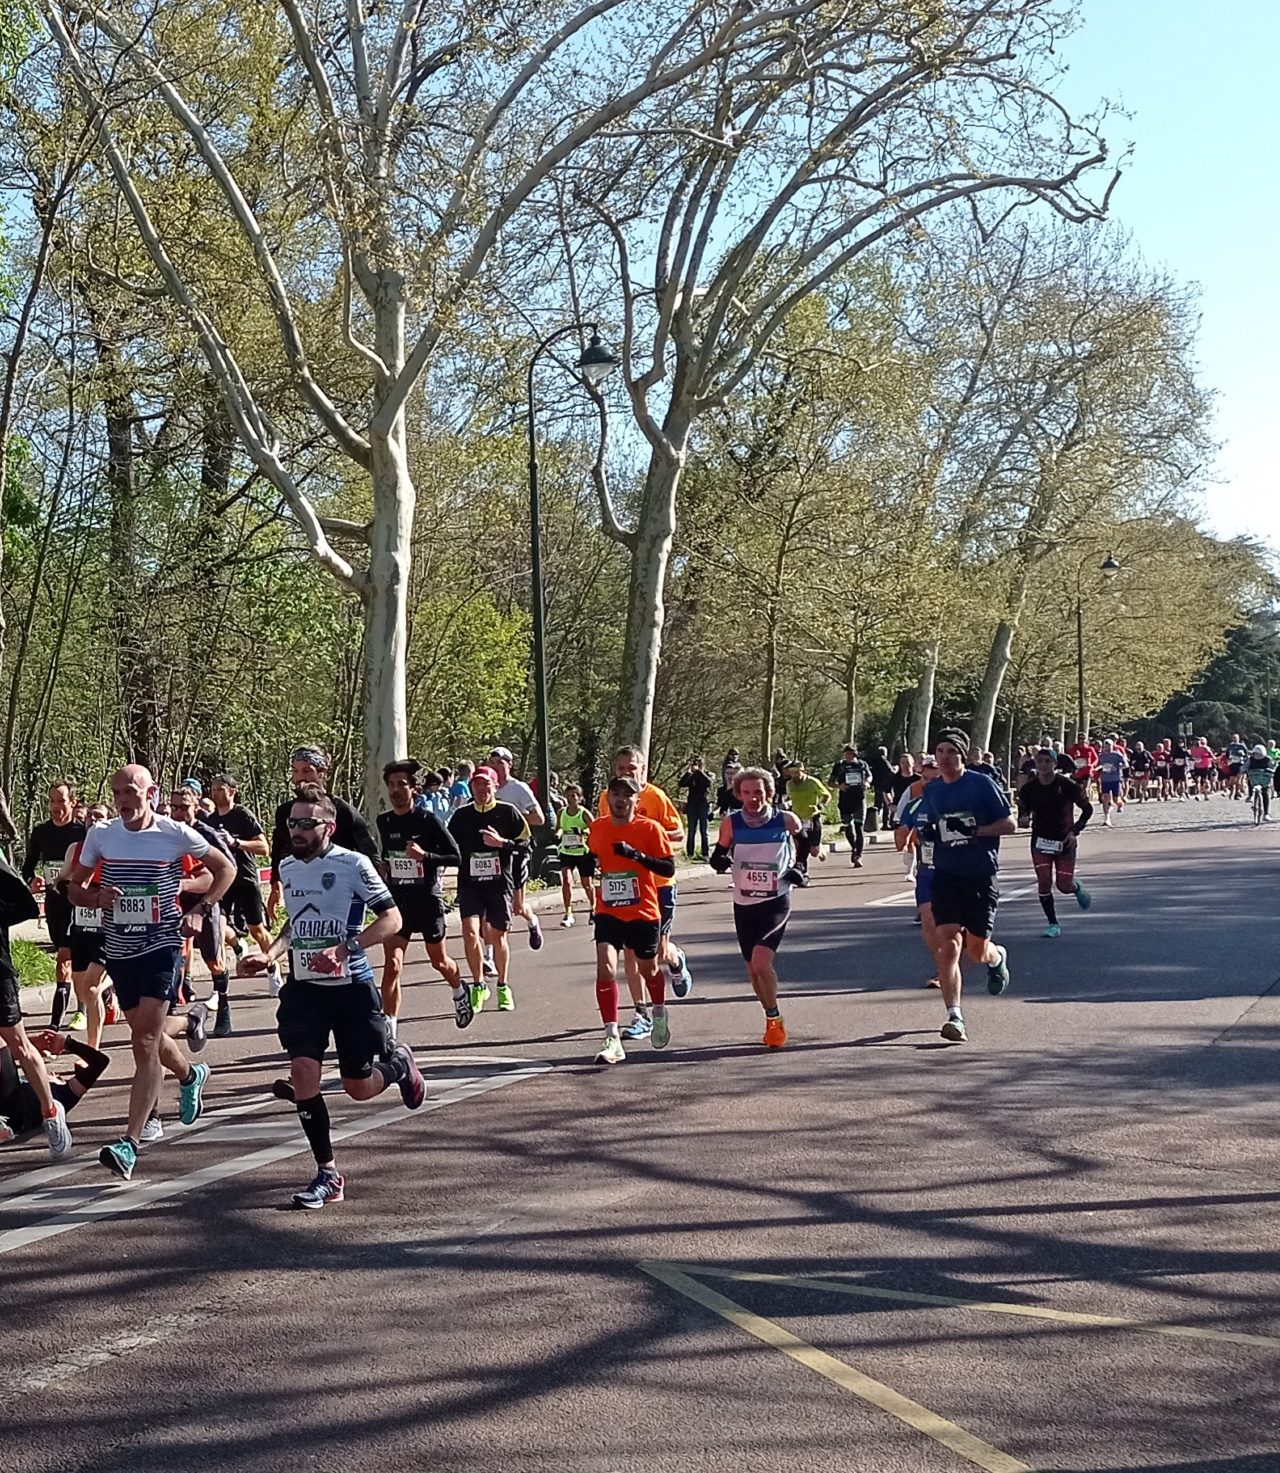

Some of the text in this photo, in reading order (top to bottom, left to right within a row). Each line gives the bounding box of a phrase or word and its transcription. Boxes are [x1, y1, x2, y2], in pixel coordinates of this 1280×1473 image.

[747, 872, 768, 882] 4655
[120, 899, 145, 913] 6883
[79, 908, 97, 919] 4564
